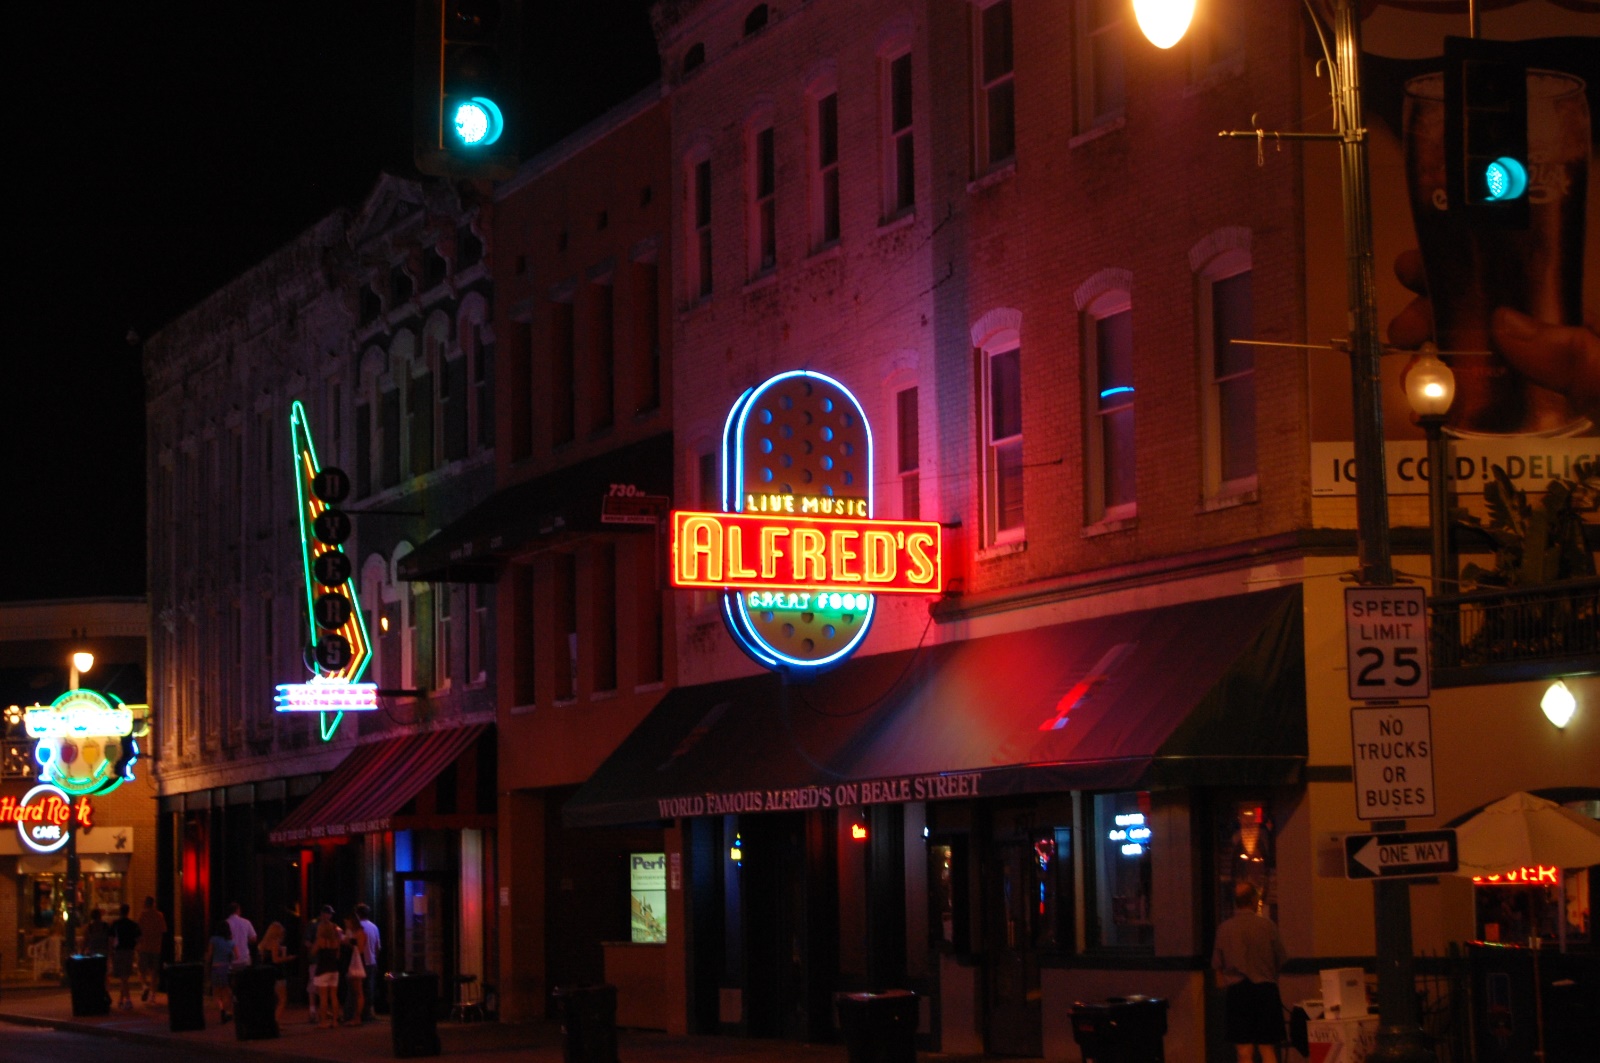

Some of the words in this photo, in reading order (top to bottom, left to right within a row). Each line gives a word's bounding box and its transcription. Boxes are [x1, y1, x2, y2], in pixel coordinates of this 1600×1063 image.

[1334, 458, 1357, 483] IC
[1396, 456, 1488, 482] COD!
[747, 494, 794, 512] LIVE
[802, 496, 867, 517] MUSIC
[682, 516, 934, 584] ALFRED'S
[1352, 600, 1419, 617] SPEED
[1360, 623, 1413, 641] LIMIT
[1356, 646, 1421, 687] 25
[1379, 719, 1404, 736] NO
[1357, 740, 1428, 761] TRUCKS
[1383, 765, 1407, 783] OR
[658, 797, 704, 818] WORLD
[706, 791, 762, 814] FAMOUS
[764, 786, 832, 811] ALFRED'S
[835, 783, 858, 806] ON
[861, 779, 911, 805] BEALE
[914, 773, 983, 799] STREET
[1366, 787, 1426, 807] BUSES
[0, 796, 46, 822] Hard
[47, 796, 92, 826] Rok
[1379, 845, 1410, 864] ONE
[1414, 843, 1445, 861] WAY
